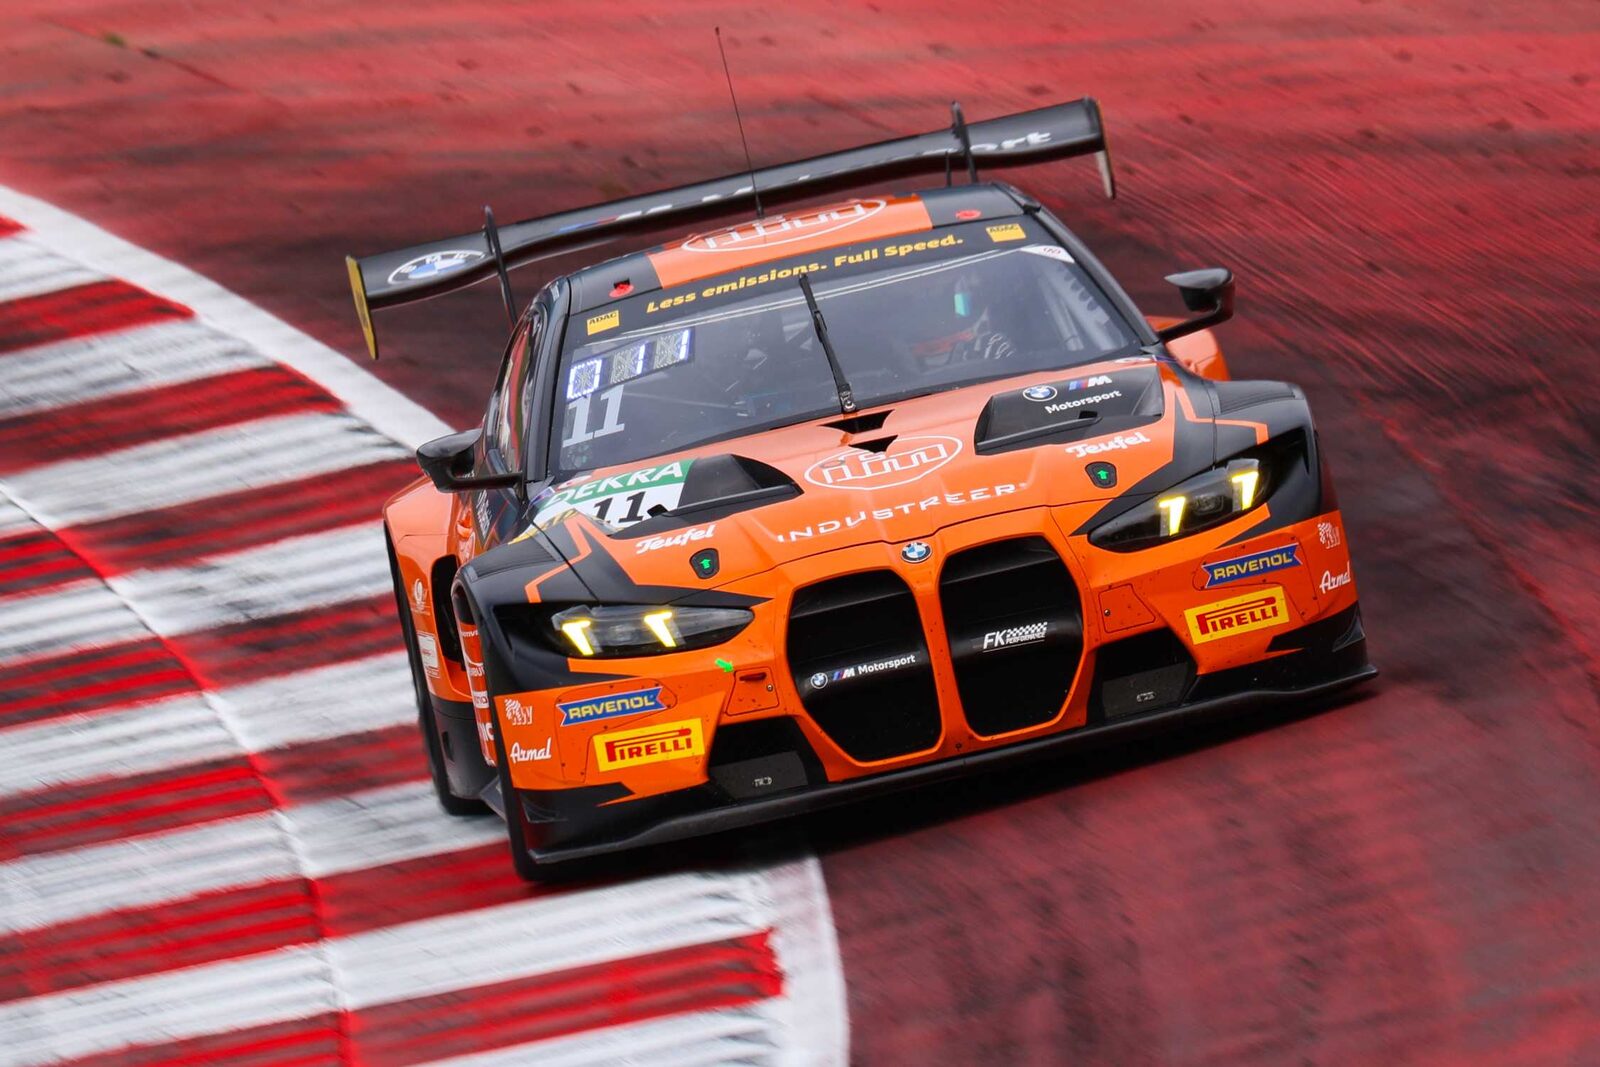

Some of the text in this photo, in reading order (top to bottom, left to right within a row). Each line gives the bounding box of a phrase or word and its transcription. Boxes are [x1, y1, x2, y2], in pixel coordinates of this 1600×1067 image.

[646, 233, 963, 313] Less emissions. Full Speed.
[589, 312, 617, 324] ADAC
[563, 384, 625, 448] 11
[1044, 389, 1122, 414] Motorsport
[1065, 432, 1151, 458] Teufel
[544, 461, 683, 508] DEKRA
[593, 491, 647, 524] 11
[777, 483, 1016, 542] INDUSTREER
[635, 524, 716, 554] Teufel
[1213, 551, 1293, 580] RAVENOL
[1196, 596, 1279, 635] PIRELLI
[983, 630, 1007, 649] FK
[858, 654, 916, 675] Motorsport
[568, 695, 655, 719] RAVENOL
[510, 737, 552, 764] Armal
[605, 728, 692, 762] PIRELLI
